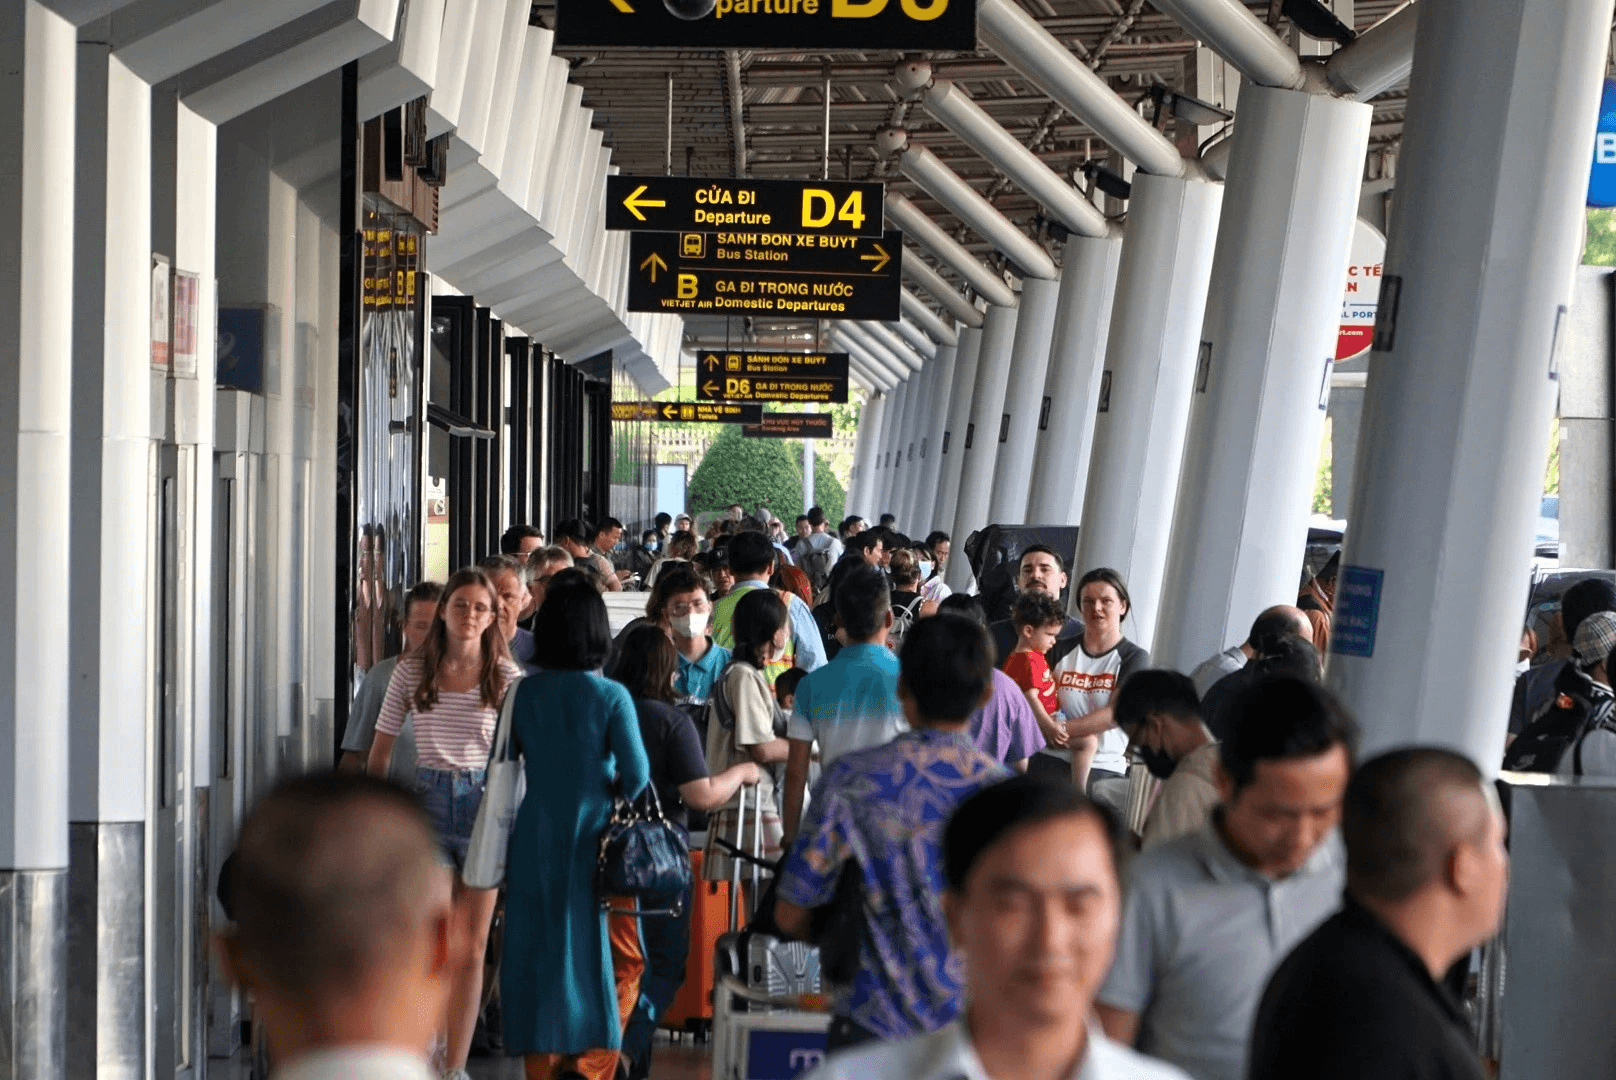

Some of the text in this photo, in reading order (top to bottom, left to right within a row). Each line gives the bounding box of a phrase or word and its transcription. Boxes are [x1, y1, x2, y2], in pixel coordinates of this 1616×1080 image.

[715, 0, 819, 18] parture
[695, 184, 756, 205] CỬA ĐI
[802, 188, 866, 229] D4
[694, 209, 771, 226] Departure
[796, 234, 815, 247] XE
[717, 248, 789, 261] Bus Station
[677, 273, 699, 299] B
[715, 281, 854, 297] GA ĐI TRONG NƯỚC
[661, 299, 713, 309] VIETJET AIR
[715, 296, 846, 313] Domestic Departures
[726, 378, 750, 394] D6
[1061, 673, 1112, 689] Dickies
